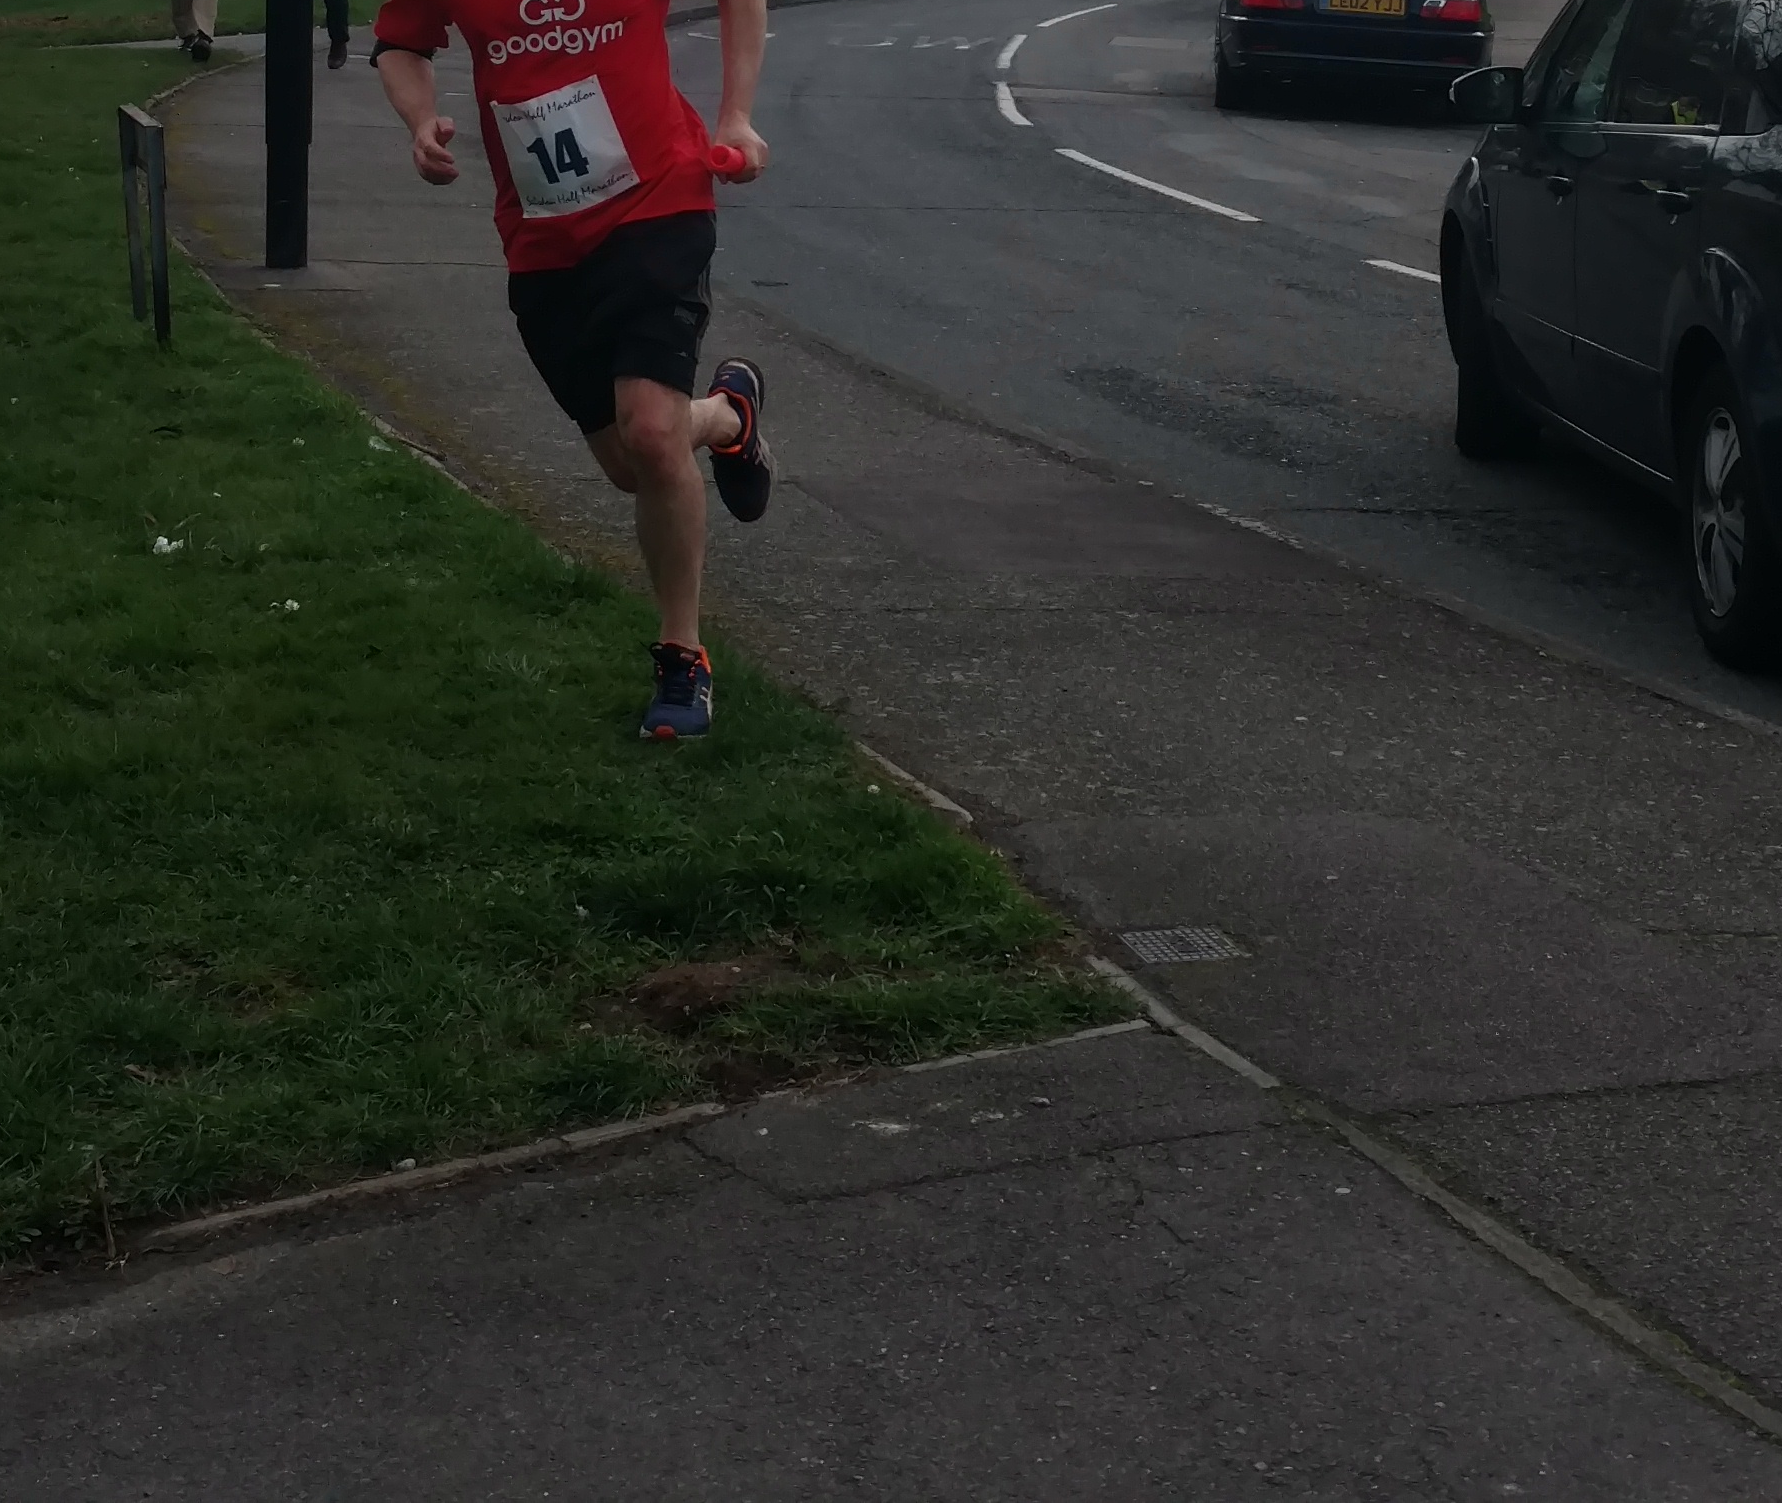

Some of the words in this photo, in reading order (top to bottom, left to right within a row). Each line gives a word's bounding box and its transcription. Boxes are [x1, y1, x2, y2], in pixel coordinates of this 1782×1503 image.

[487, 20, 624, 64] goodgym
[547, 90, 596, 114] Marathon
[527, 127, 590, 185] 14
[580, 172, 629, 197] Marathon
